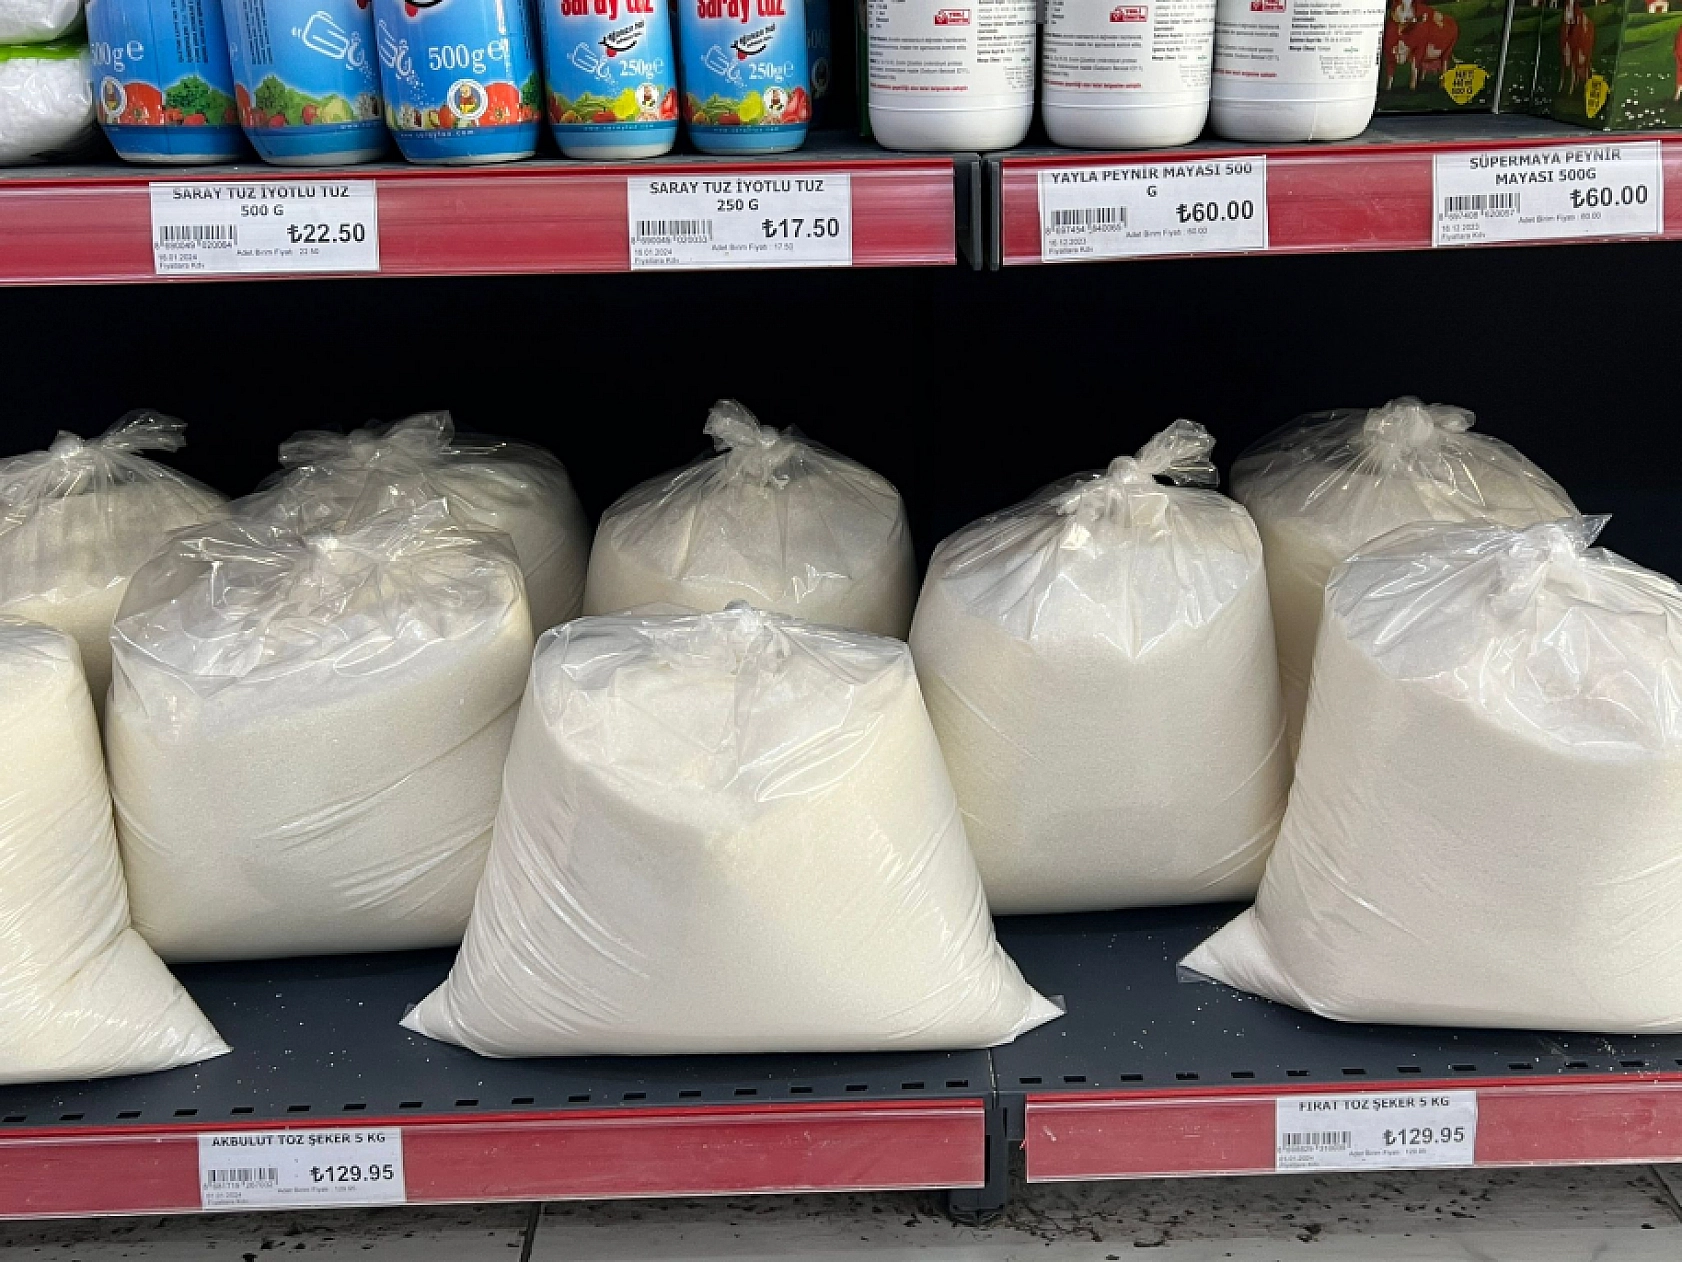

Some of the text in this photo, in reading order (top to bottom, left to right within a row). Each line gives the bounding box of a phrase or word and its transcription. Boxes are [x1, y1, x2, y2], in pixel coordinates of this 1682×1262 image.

[1469, 148, 1621, 170] SÜPERMAYA PEYNİR
[1051, 163, 1252, 184] YAYLA PEYNİR MAYASI 500
[1495, 167, 1597, 186] MAYASI 500G
[173, 185, 349, 199] SARAY TUZ İYOTLU TUZ
[650, 179, 824, 194] SARAY TUZ İYOTLU TUZ
[1146, 185, 1157, 197] G
[1569, 184, 1648, 208] ₺60.00
[241, 204, 284, 217] 500 G
[717, 199, 759, 212] 250 G
[1175, 199, 1254, 223] ₺60.00
[286, 223, 365, 243] ₺22.50
[762, 217, 840, 238] ₺17.50
[1299, 1096, 1450, 1112] FIRAT TOZ ŞEKER 5 KG
[212, 1132, 385, 1147] AKBULUT TOZ ŞEKER 5 KG
[1382, 1126, 1465, 1146] ₺129.95
[309, 1164, 394, 1183] ₺129.95
